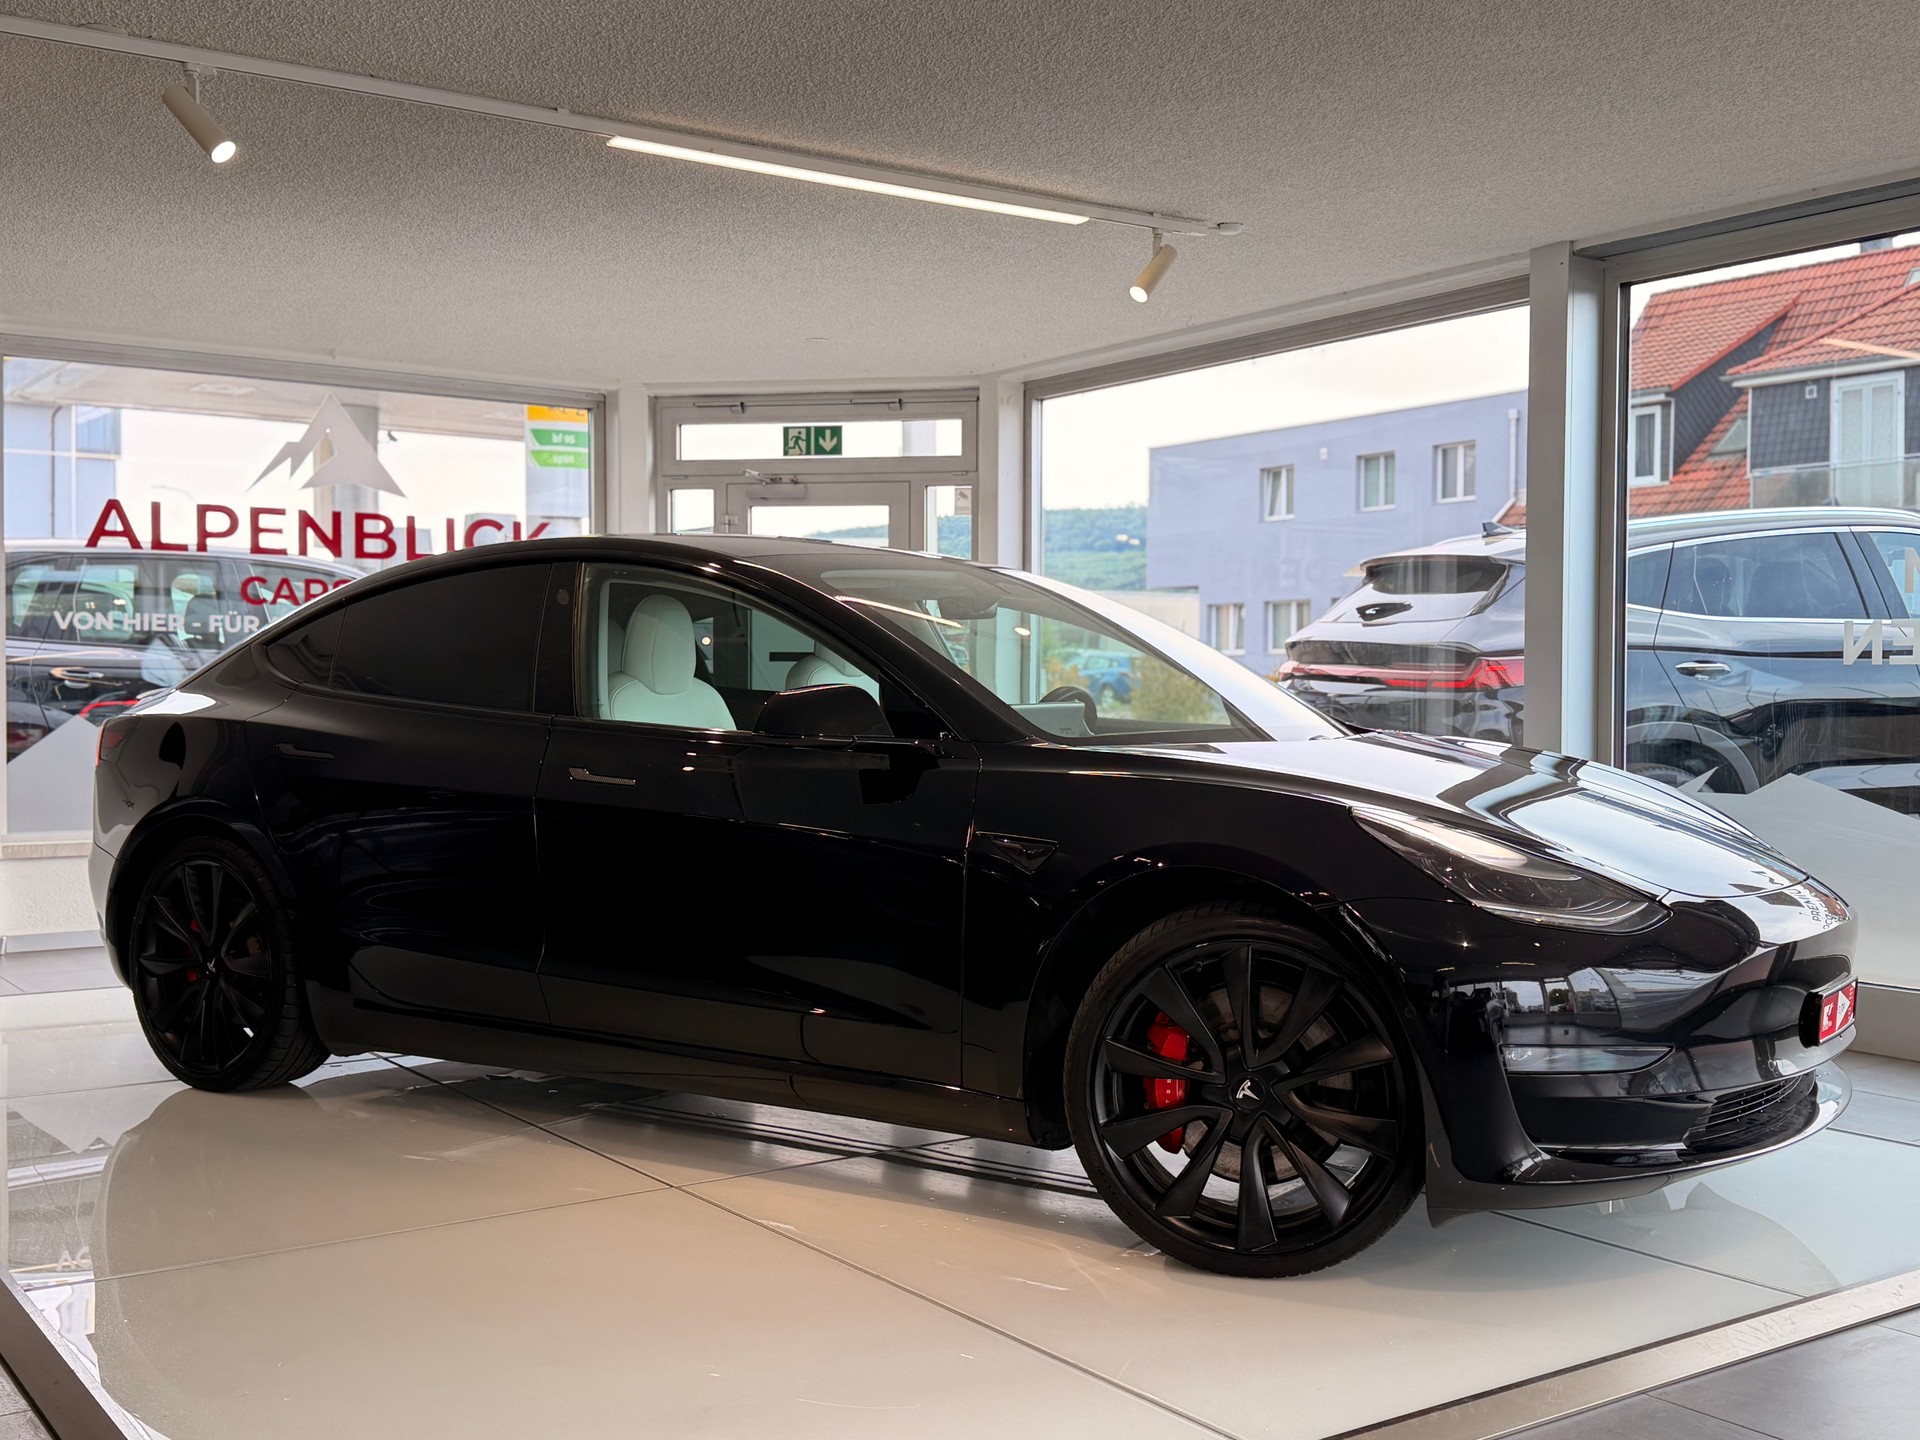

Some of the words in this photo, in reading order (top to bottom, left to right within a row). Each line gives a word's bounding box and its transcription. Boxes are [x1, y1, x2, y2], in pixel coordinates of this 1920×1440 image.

[240, 575, 353, 606] CAR
[53, 610, 114, 631] VON
[123, 612, 185, 632] HIER
[209, 611, 260, 633] FÜR
